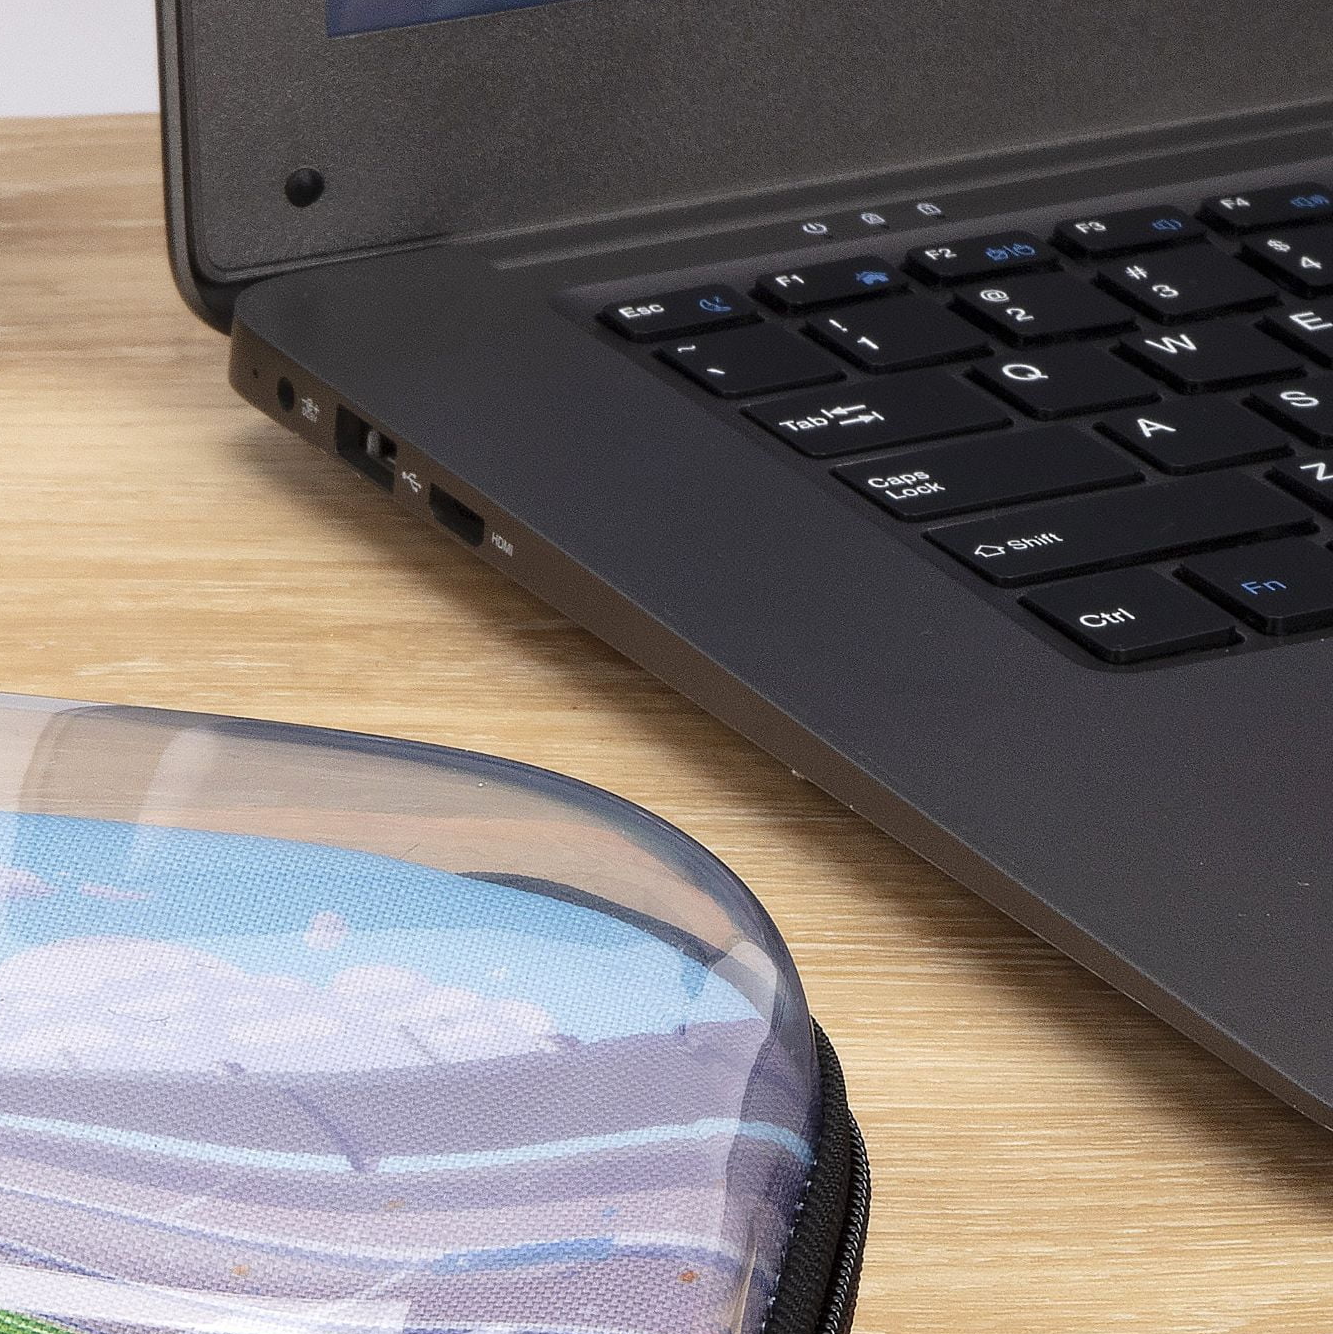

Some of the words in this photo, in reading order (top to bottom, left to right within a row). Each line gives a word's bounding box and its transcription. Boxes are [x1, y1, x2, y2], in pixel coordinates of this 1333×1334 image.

[1220, 197, 1251, 210] F4
[1075, 221, 1107, 234] F3
[924, 247, 957, 260] F2
[1301, 256, 1323, 270] 4
[775, 274, 805, 289] F1
[1124, 265, 1148, 280] #
[980, 289, 1010, 302] @
[1152, 284, 1180, 298] 3
[618, 303, 665, 319] Esc
[1005, 307, 1034, 322] 2
[1289, 311, 1333, 331] E
[857, 336, 879, 350] 1
[1144, 333, 1197, 354] W
[1002, 363, 1049, 381] Q
[1279, 390, 1320, 408] S
[778, 410, 830, 433] Tab
[1137, 417, 1177, 438] A
[867, 470, 931, 490] Caps
[885, 480, 946, 501] Lock
[491, 531, 515, 557] HDMI
[1006, 531, 1064, 551] Shift
[1240, 578, 1288, 596] Fn
[1078, 607, 1137, 629] Ctrl
